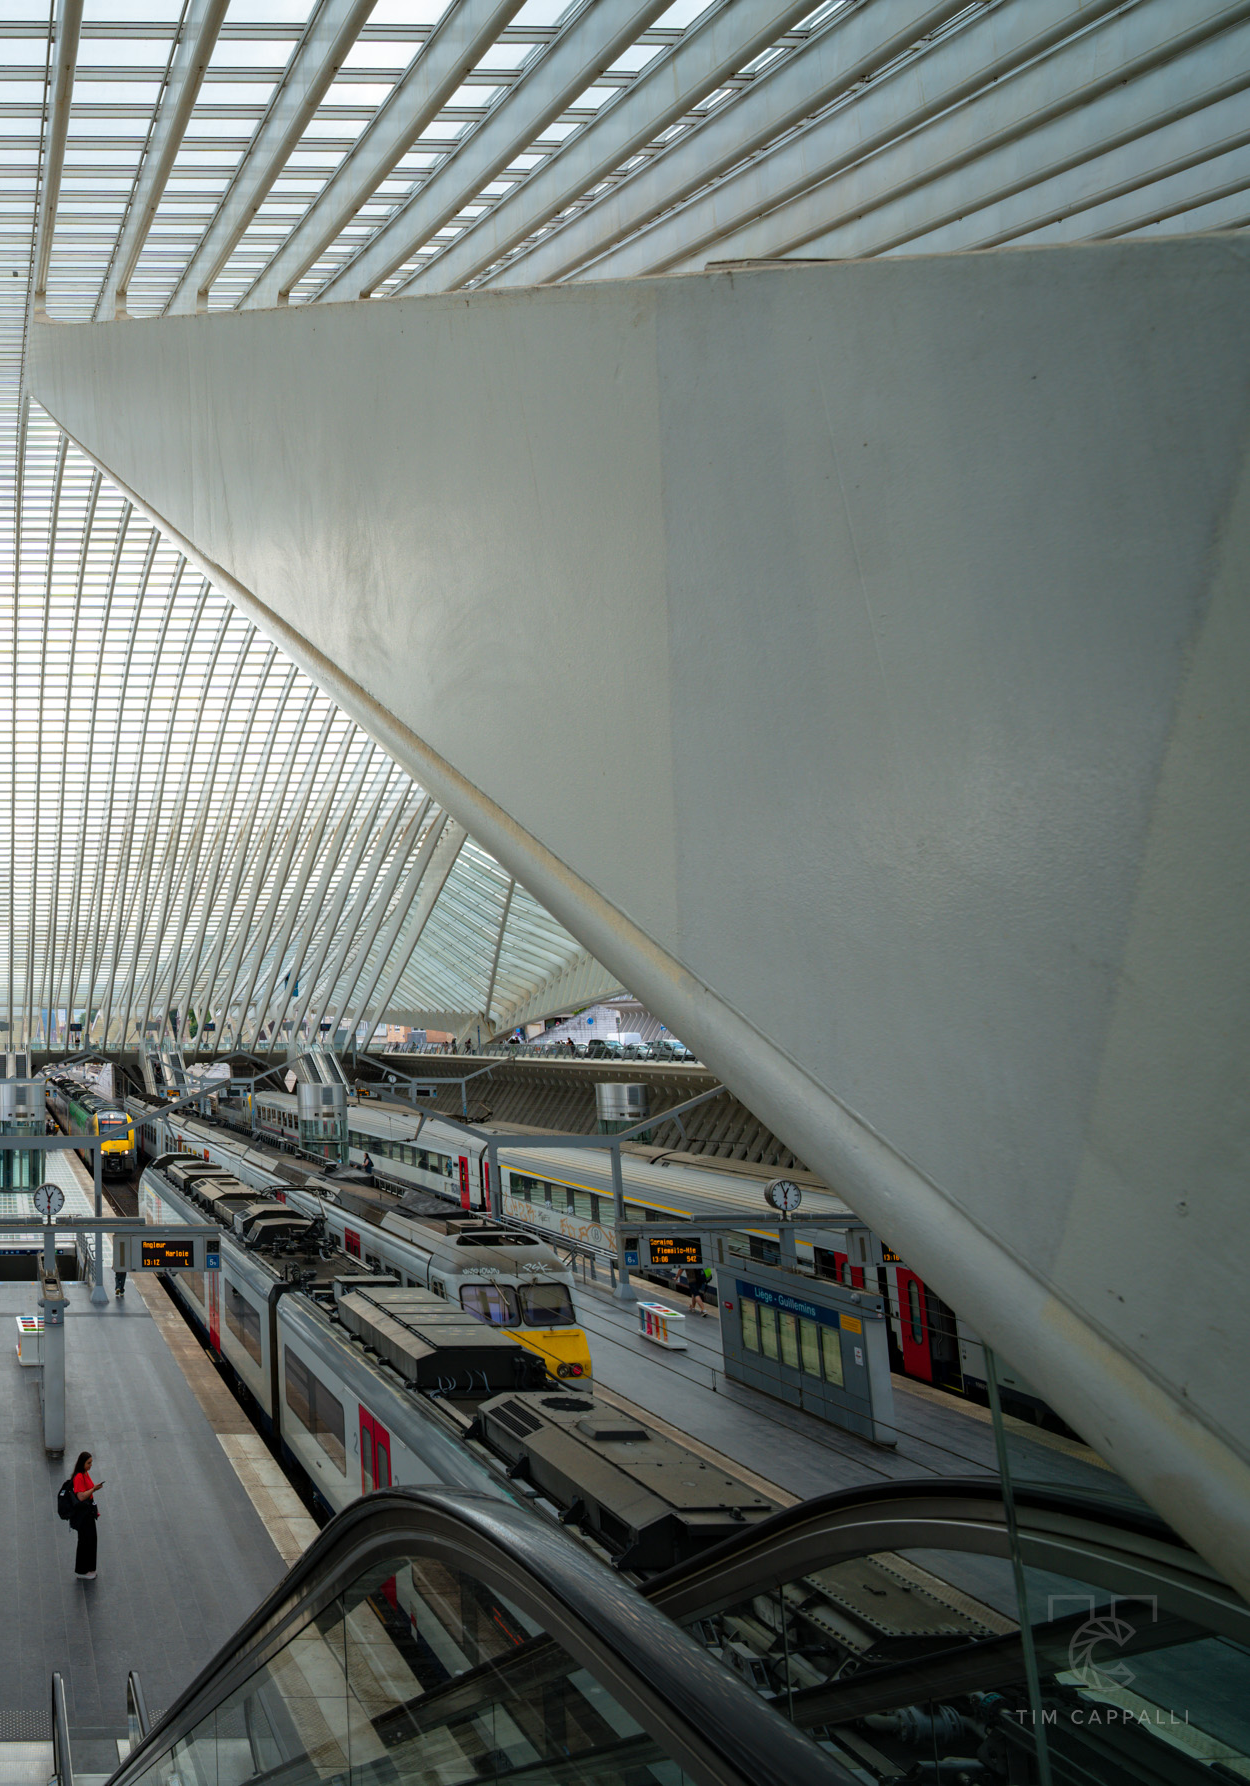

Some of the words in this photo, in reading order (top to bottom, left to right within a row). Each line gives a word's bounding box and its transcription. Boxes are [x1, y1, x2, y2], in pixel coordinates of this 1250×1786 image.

[142, 1241, 166, 1249] Angleur
[754, 1286, 773, 1303] Liège
[778, 1294, 816, 1317] Guillemins
